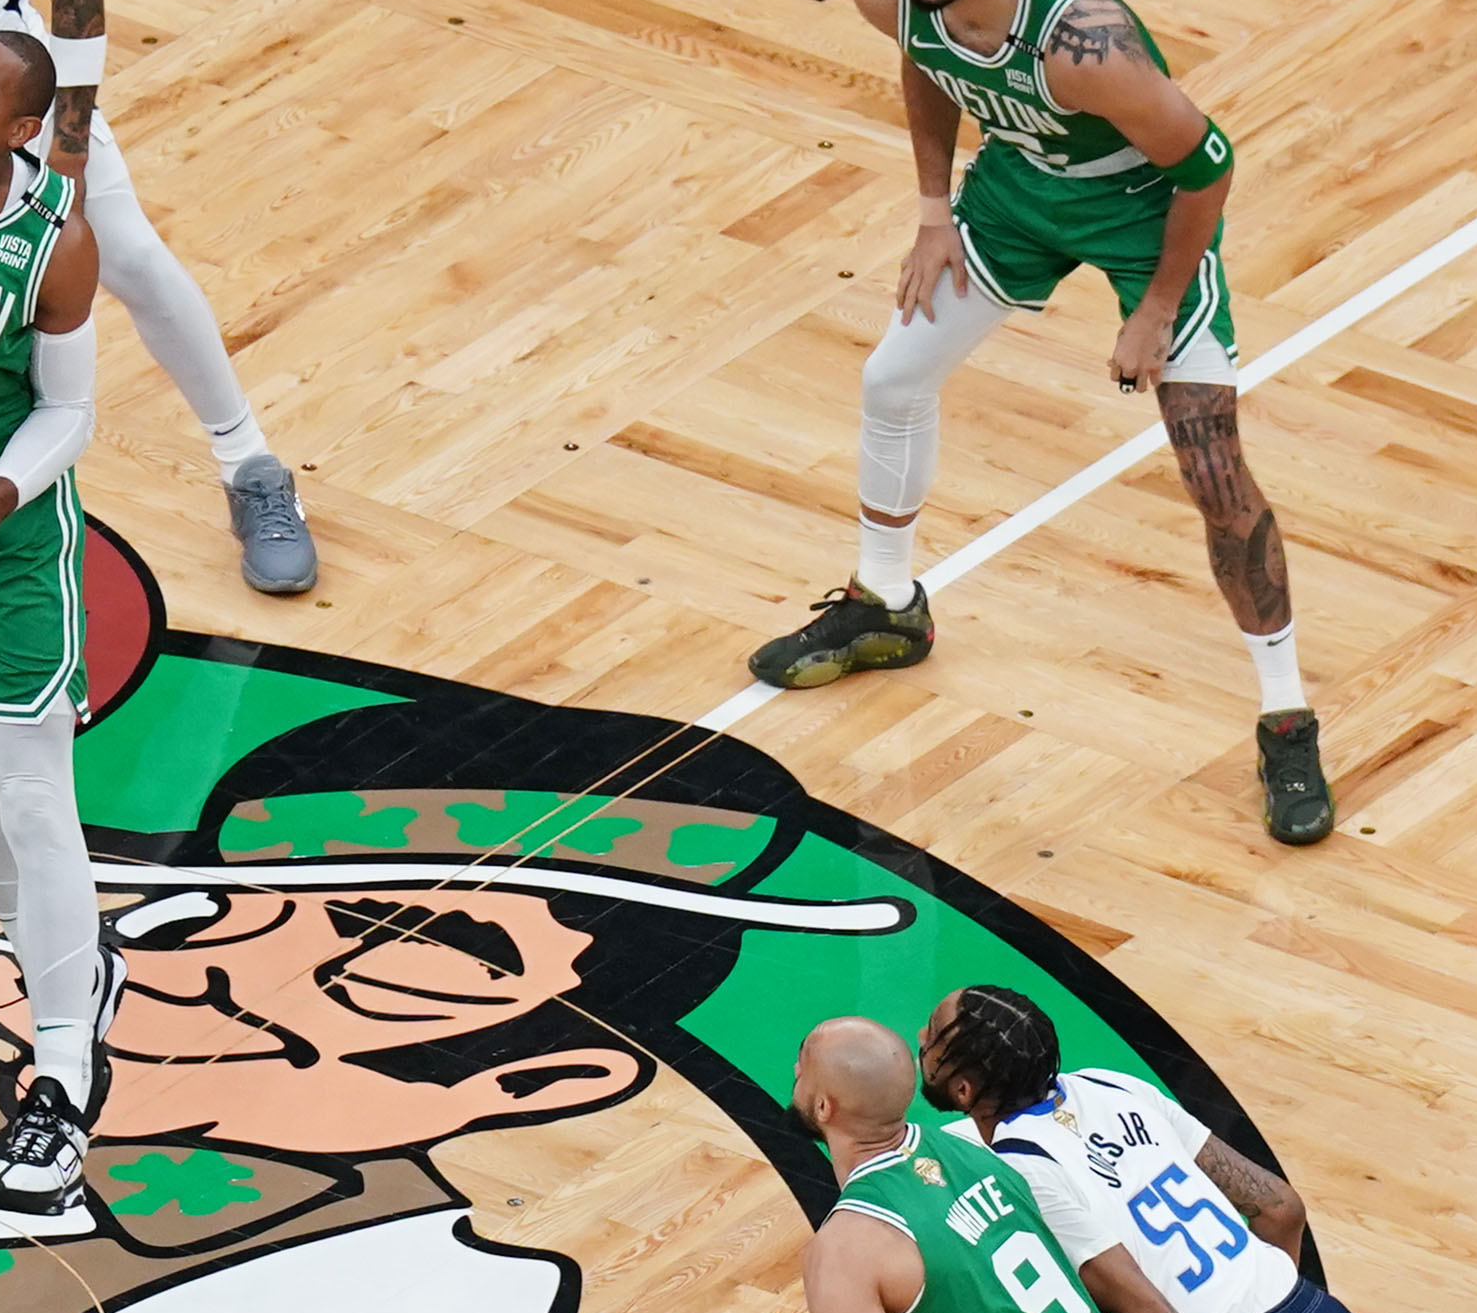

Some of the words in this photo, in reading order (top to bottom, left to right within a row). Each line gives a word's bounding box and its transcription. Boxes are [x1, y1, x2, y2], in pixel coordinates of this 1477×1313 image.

[29, 196, 58, 223] WALTON
[0, 234, 33, 261] VISTA
[1117, 1111, 1160, 1147] JR.
[945, 1174, 1015, 1246] WHITE
[1126, 1161, 1250, 1293] 55
